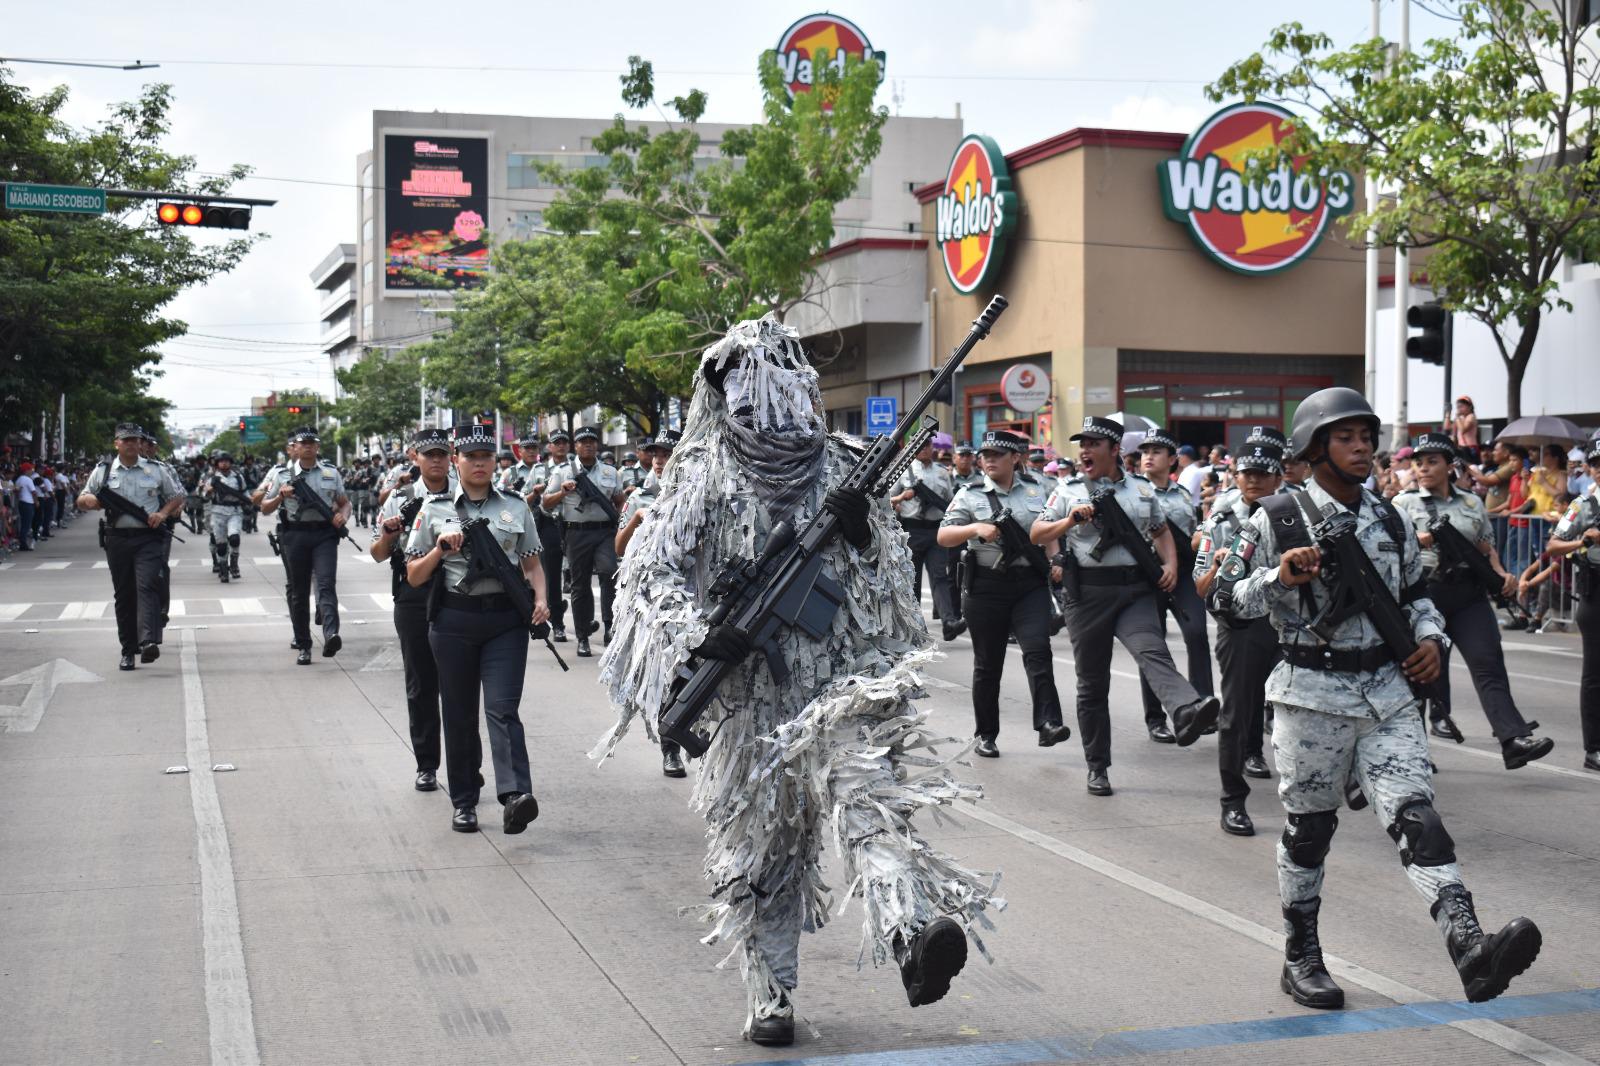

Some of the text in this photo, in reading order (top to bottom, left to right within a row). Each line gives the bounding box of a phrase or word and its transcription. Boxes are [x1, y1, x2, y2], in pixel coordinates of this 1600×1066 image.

[10, 192, 101, 209] MARIANO ESCOBEDO
[937, 177, 1004, 242] Waldo's
